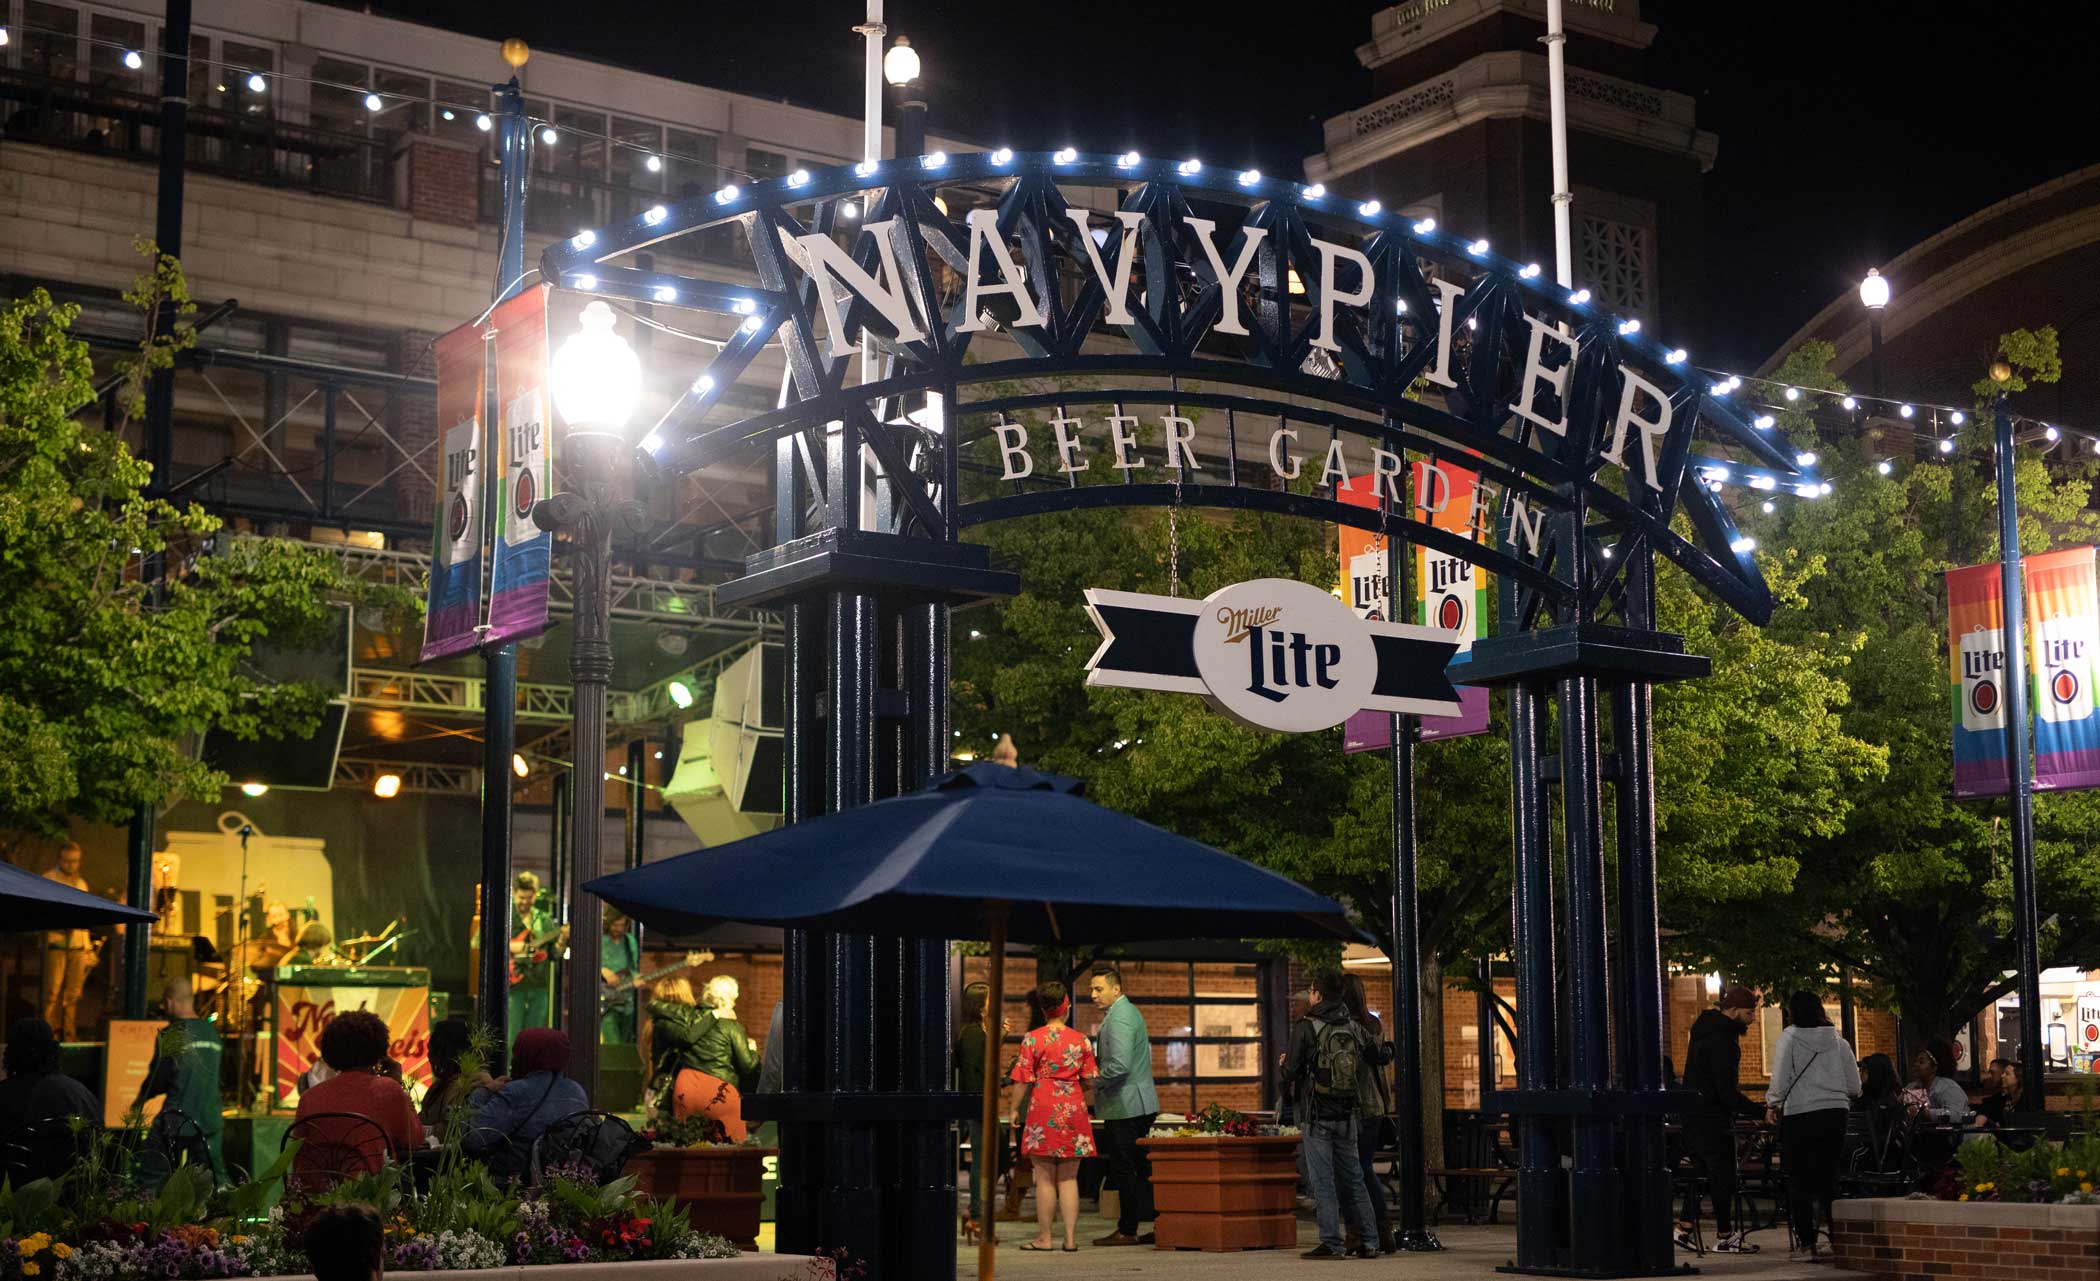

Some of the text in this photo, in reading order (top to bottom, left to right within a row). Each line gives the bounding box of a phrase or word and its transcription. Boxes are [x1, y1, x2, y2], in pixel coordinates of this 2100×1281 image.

[797, 209, 1672, 492] NAVY PIER
[510, 422, 540, 467] Lite
[448, 449, 476, 492] Lite
[992, 415, 1546, 557] BEER GARDEN
[1429, 558, 1471, 594] Lite
[1217, 606, 1283, 638] Miller
[1246, 626, 1341, 703] Lite
[1963, 650, 2004, 679] Lite
